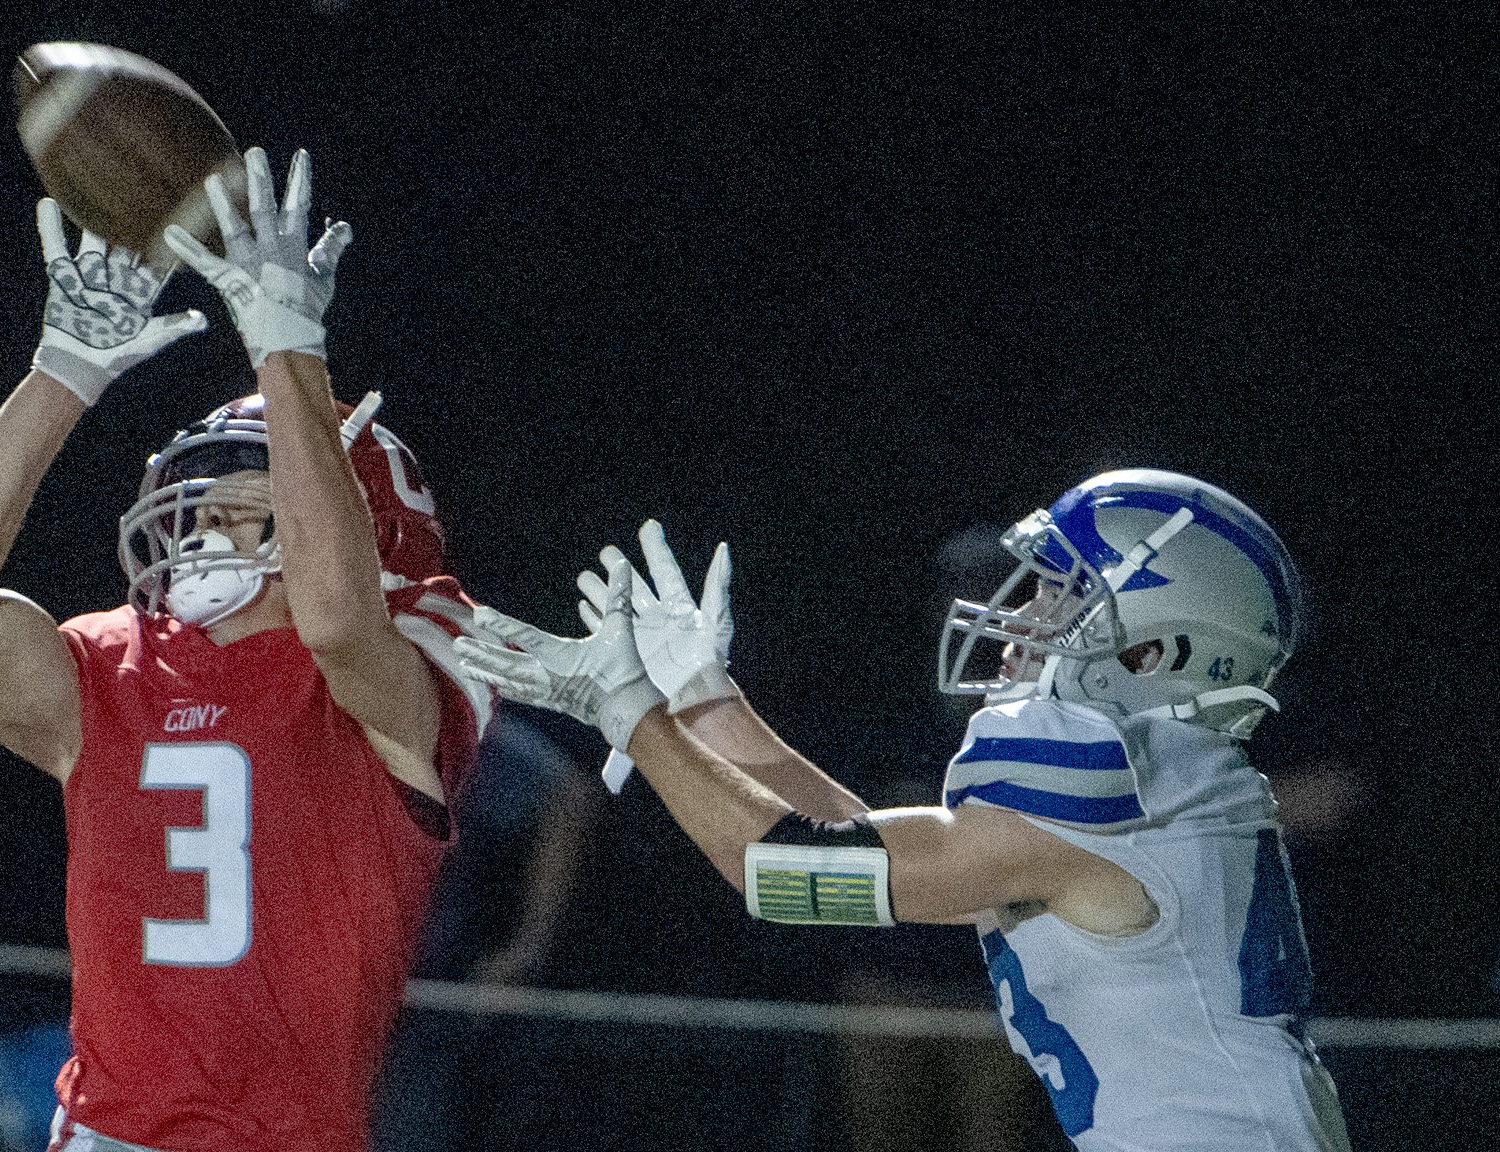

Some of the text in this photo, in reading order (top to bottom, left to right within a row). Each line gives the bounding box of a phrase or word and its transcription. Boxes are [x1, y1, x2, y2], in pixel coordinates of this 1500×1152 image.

[1207, 656, 1235, 681] 43
[164, 704, 227, 732] CONY
[138, 740, 253, 968] 3
